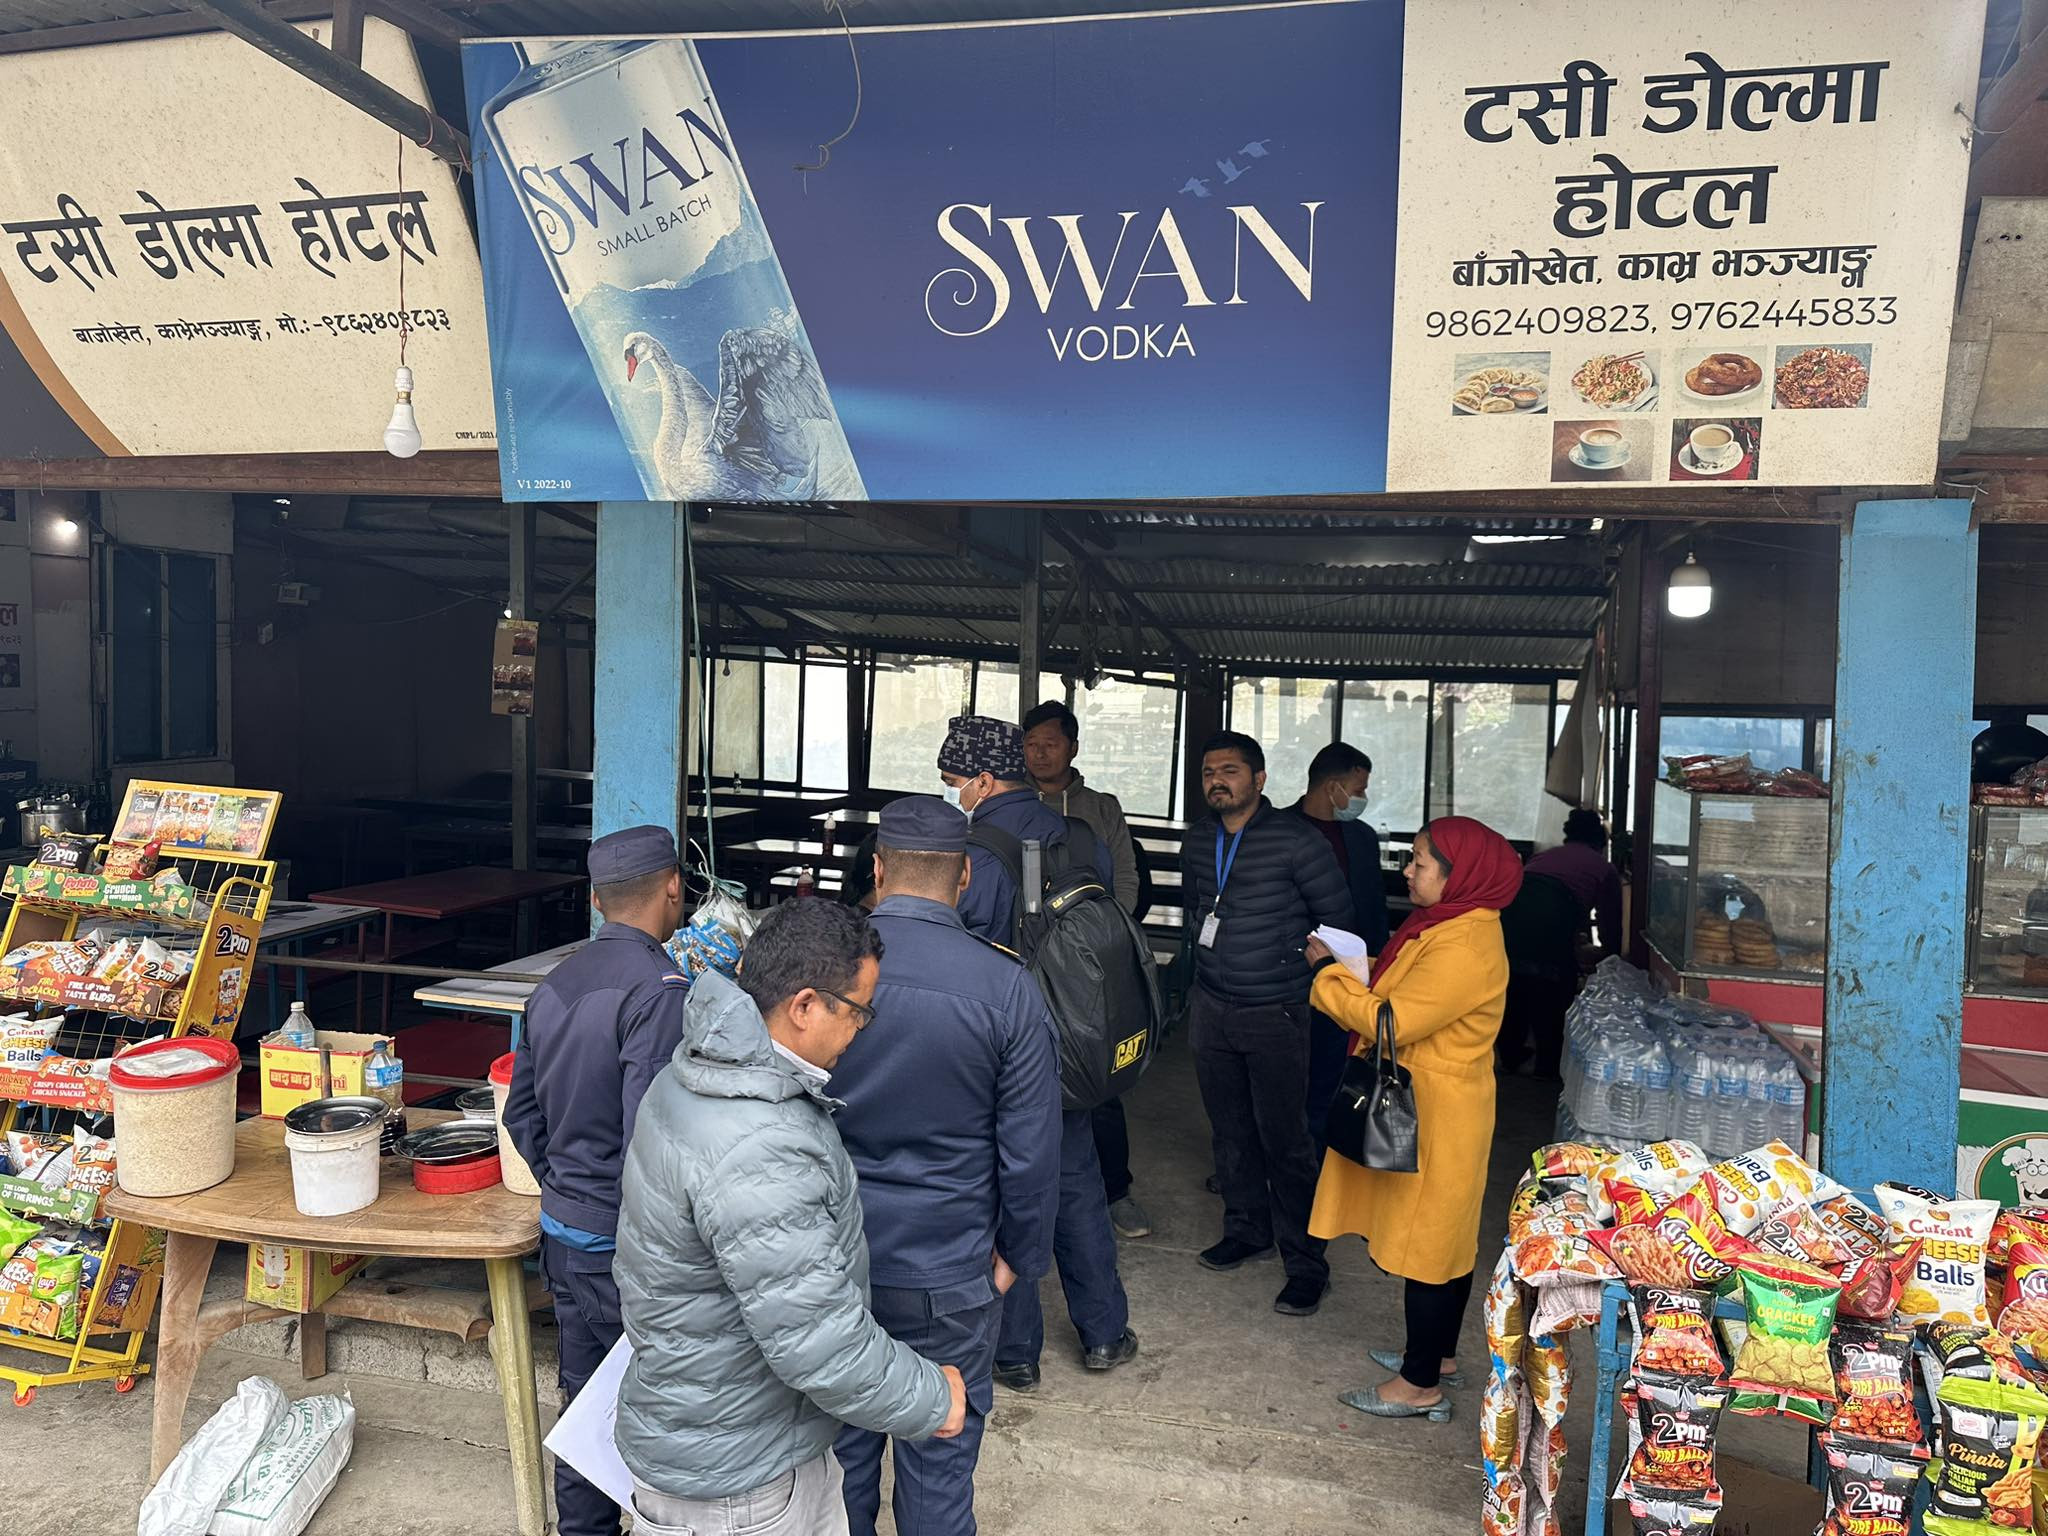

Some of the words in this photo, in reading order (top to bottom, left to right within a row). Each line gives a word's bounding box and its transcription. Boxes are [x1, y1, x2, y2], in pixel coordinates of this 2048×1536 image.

[1463, 60, 1617, 145] टसी
[1641, 51, 1890, 134] डोल्मा
[518, 96, 734, 256] SWAN
[1553, 153, 1778, 238] होटल
[2, 193, 118, 293] टसी
[120, 190, 272, 280] डोल्मा
[280, 177, 438, 280] होटल
[597, 223, 655, 256] SMALL
[656, 194, 712, 232] BATCH
[925, 200, 1325, 337] SWAN
[1426, 304, 1657, 338] 9862409823,
[1671, 296, 1898, 331] 9762445833
[1047, 322, 1196, 361] VODKA
[517, 479, 531, 489] V1
[534, 479, 572, 489] 2022-10
[64, 989, 88, 999] TASTE
[1, 1037, 49, 1050] CHEESE
[7, 1050, 42, 1061] Balls
[1115, 1035, 1144, 1068] CAT
[69, 1166, 114, 1186] CHEESE
[1, 1189, 11, 1198] OF
[25, 1193, 55, 1207] RINGS
[1908, 1219, 1974, 1239] Current
[1917, 1260, 1975, 1287] Balls
[1656, 1313, 1677, 1329] FIRE
[1756, 1303, 1817, 1328] CRACKER
[1655, 1449, 1676, 1463] FIRE
[1848, 1518, 1871, 1535] FIRE
